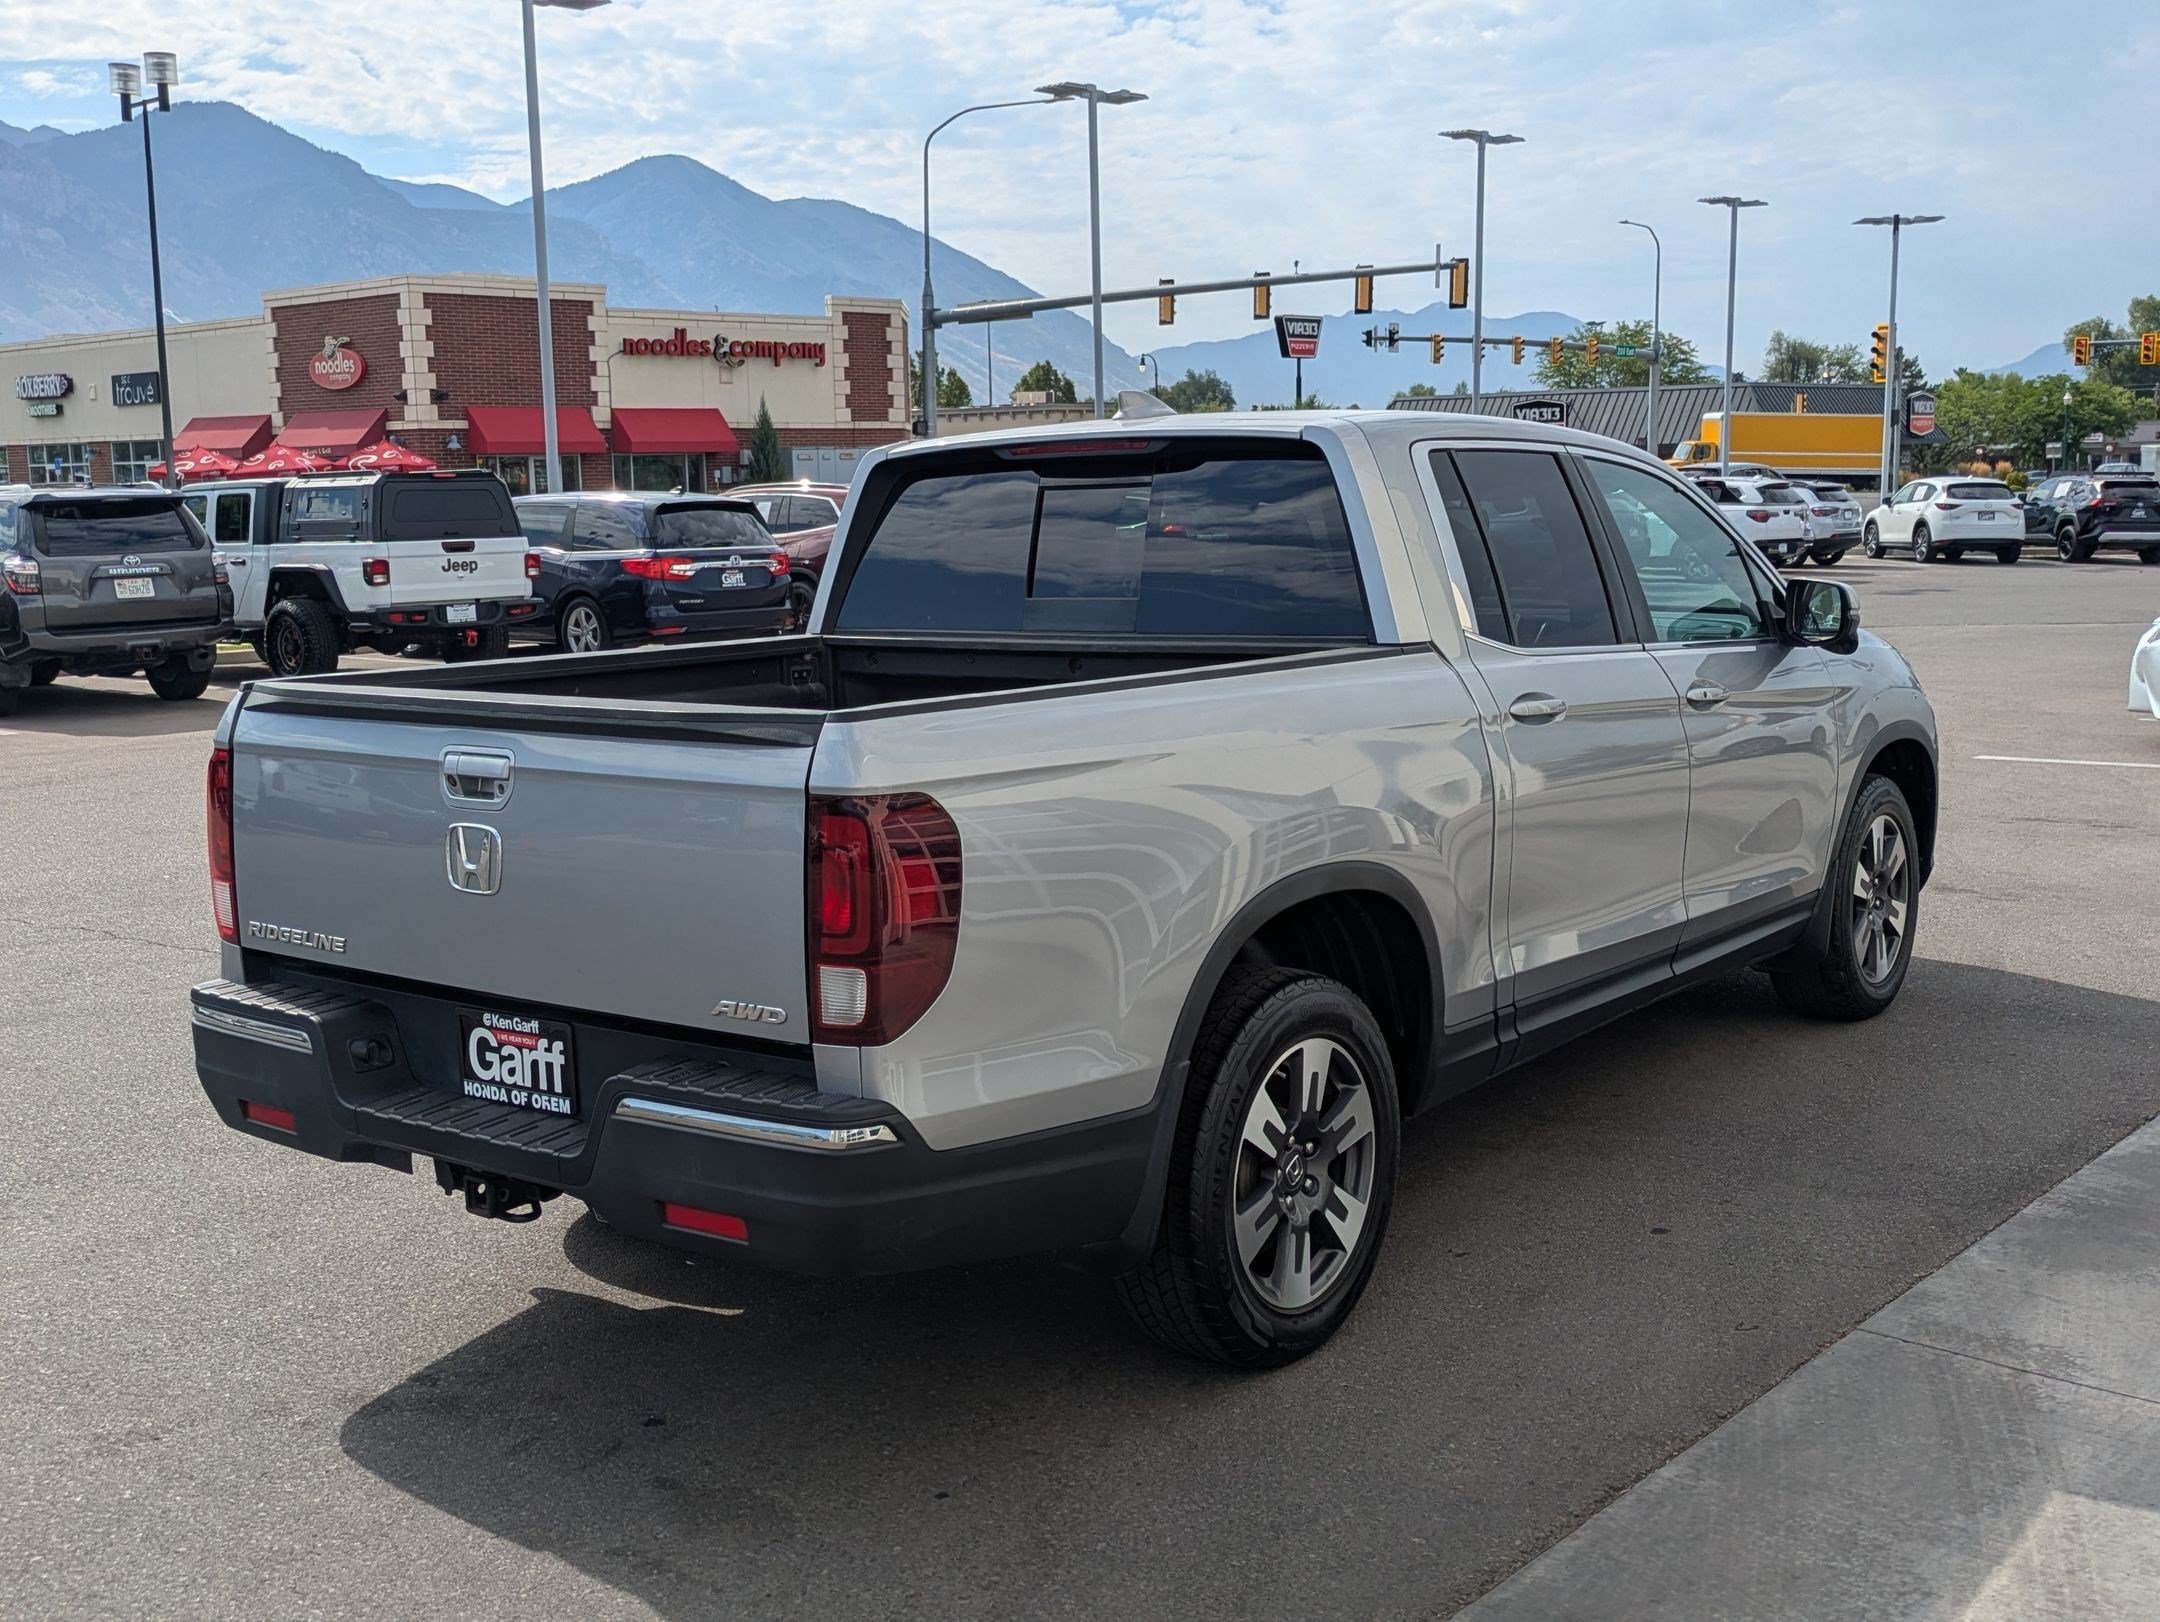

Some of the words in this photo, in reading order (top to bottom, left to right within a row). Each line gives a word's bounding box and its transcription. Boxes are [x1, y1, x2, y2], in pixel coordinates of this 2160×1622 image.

[622, 328, 712, 356] noodles
[729, 340, 826, 367] company
[314, 351, 355, 375] noodles
[15, 375, 61, 398] ROXBERRY
[441, 557, 479, 574] Jeep
[248, 920, 347, 953] RIDGELINE
[492, 1013, 512, 1030] Ken
[513, 1017, 539, 1034] Garff
[710, 1000, 788, 1025] AWD
[469, 1027, 565, 1093] Garff
[463, 1080, 508, 1103] HONDA
[511, 1090, 528, 1106] OF
[532, 1094, 571, 1114] OREM
